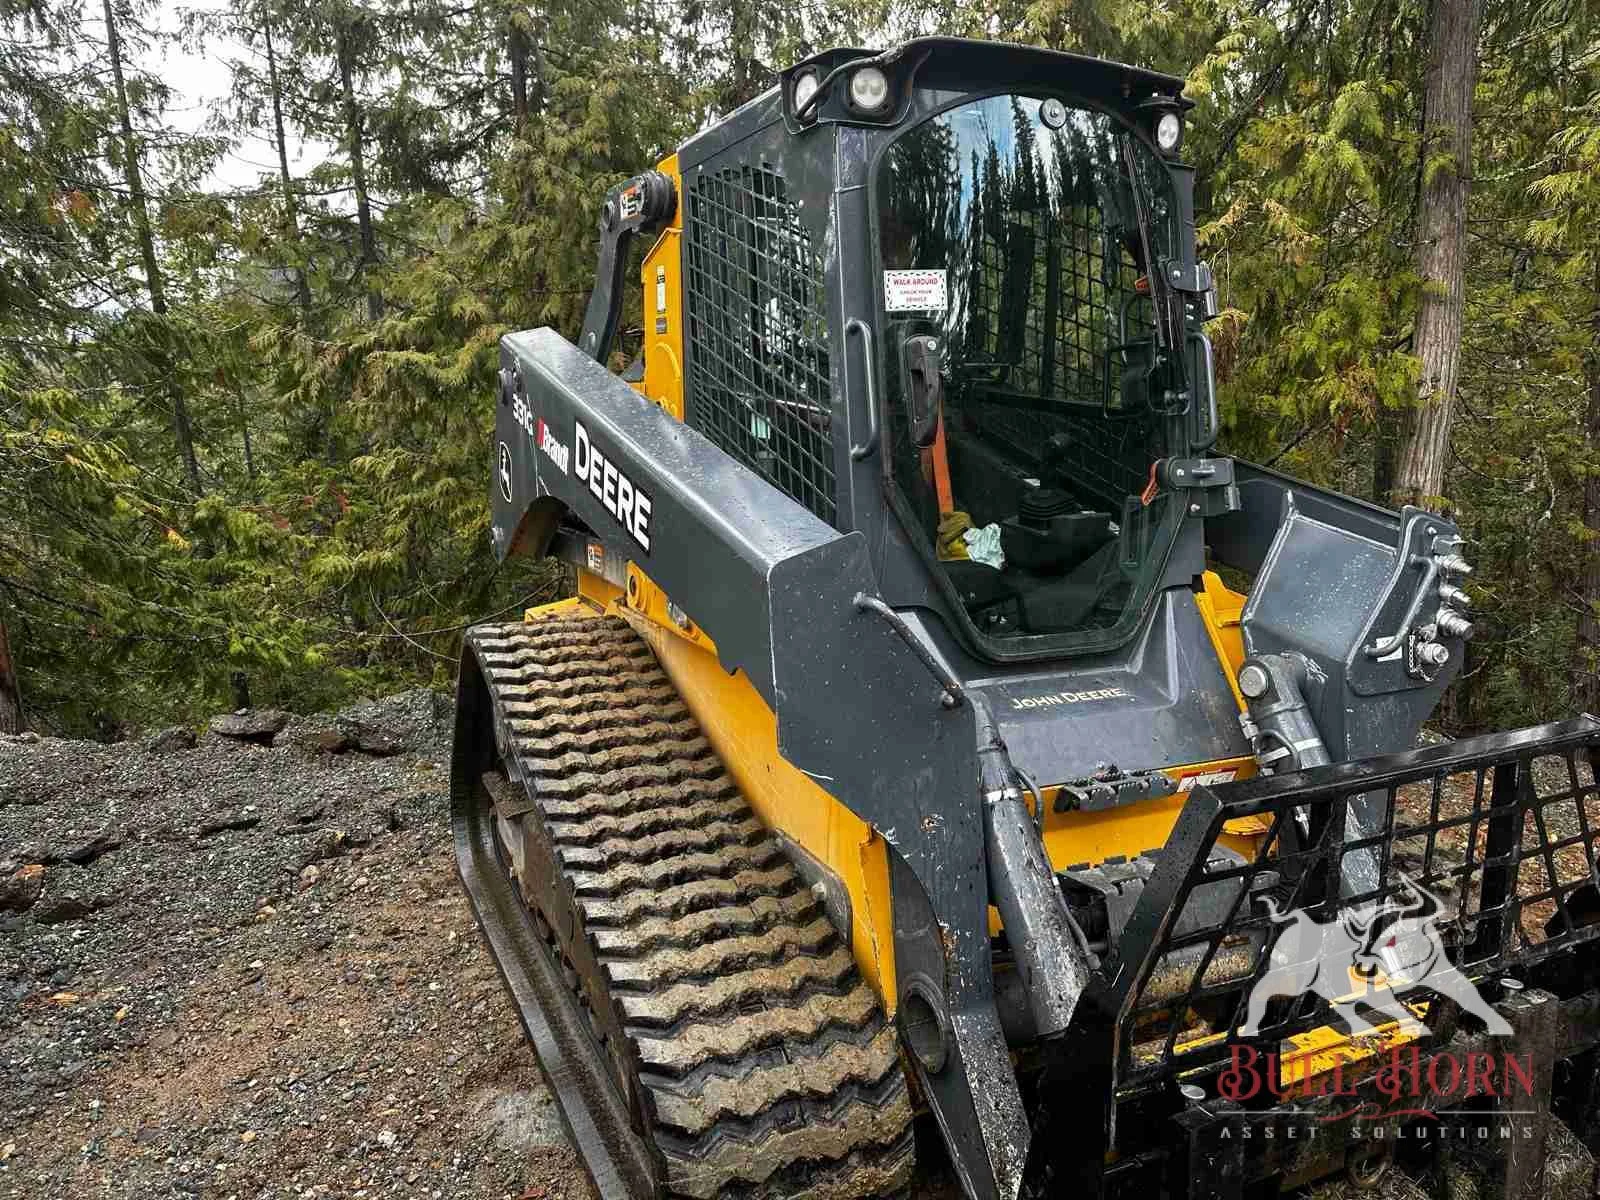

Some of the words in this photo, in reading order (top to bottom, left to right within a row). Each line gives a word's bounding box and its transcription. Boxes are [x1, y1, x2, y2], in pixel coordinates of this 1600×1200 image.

[893, 278, 911, 286] WALK
[912, 277, 938, 286] AROUND
[575, 421, 651, 551] DEERE
[1013, 694, 1063, 709] JOHN
[1061, 687, 1128, 703] DEERE
